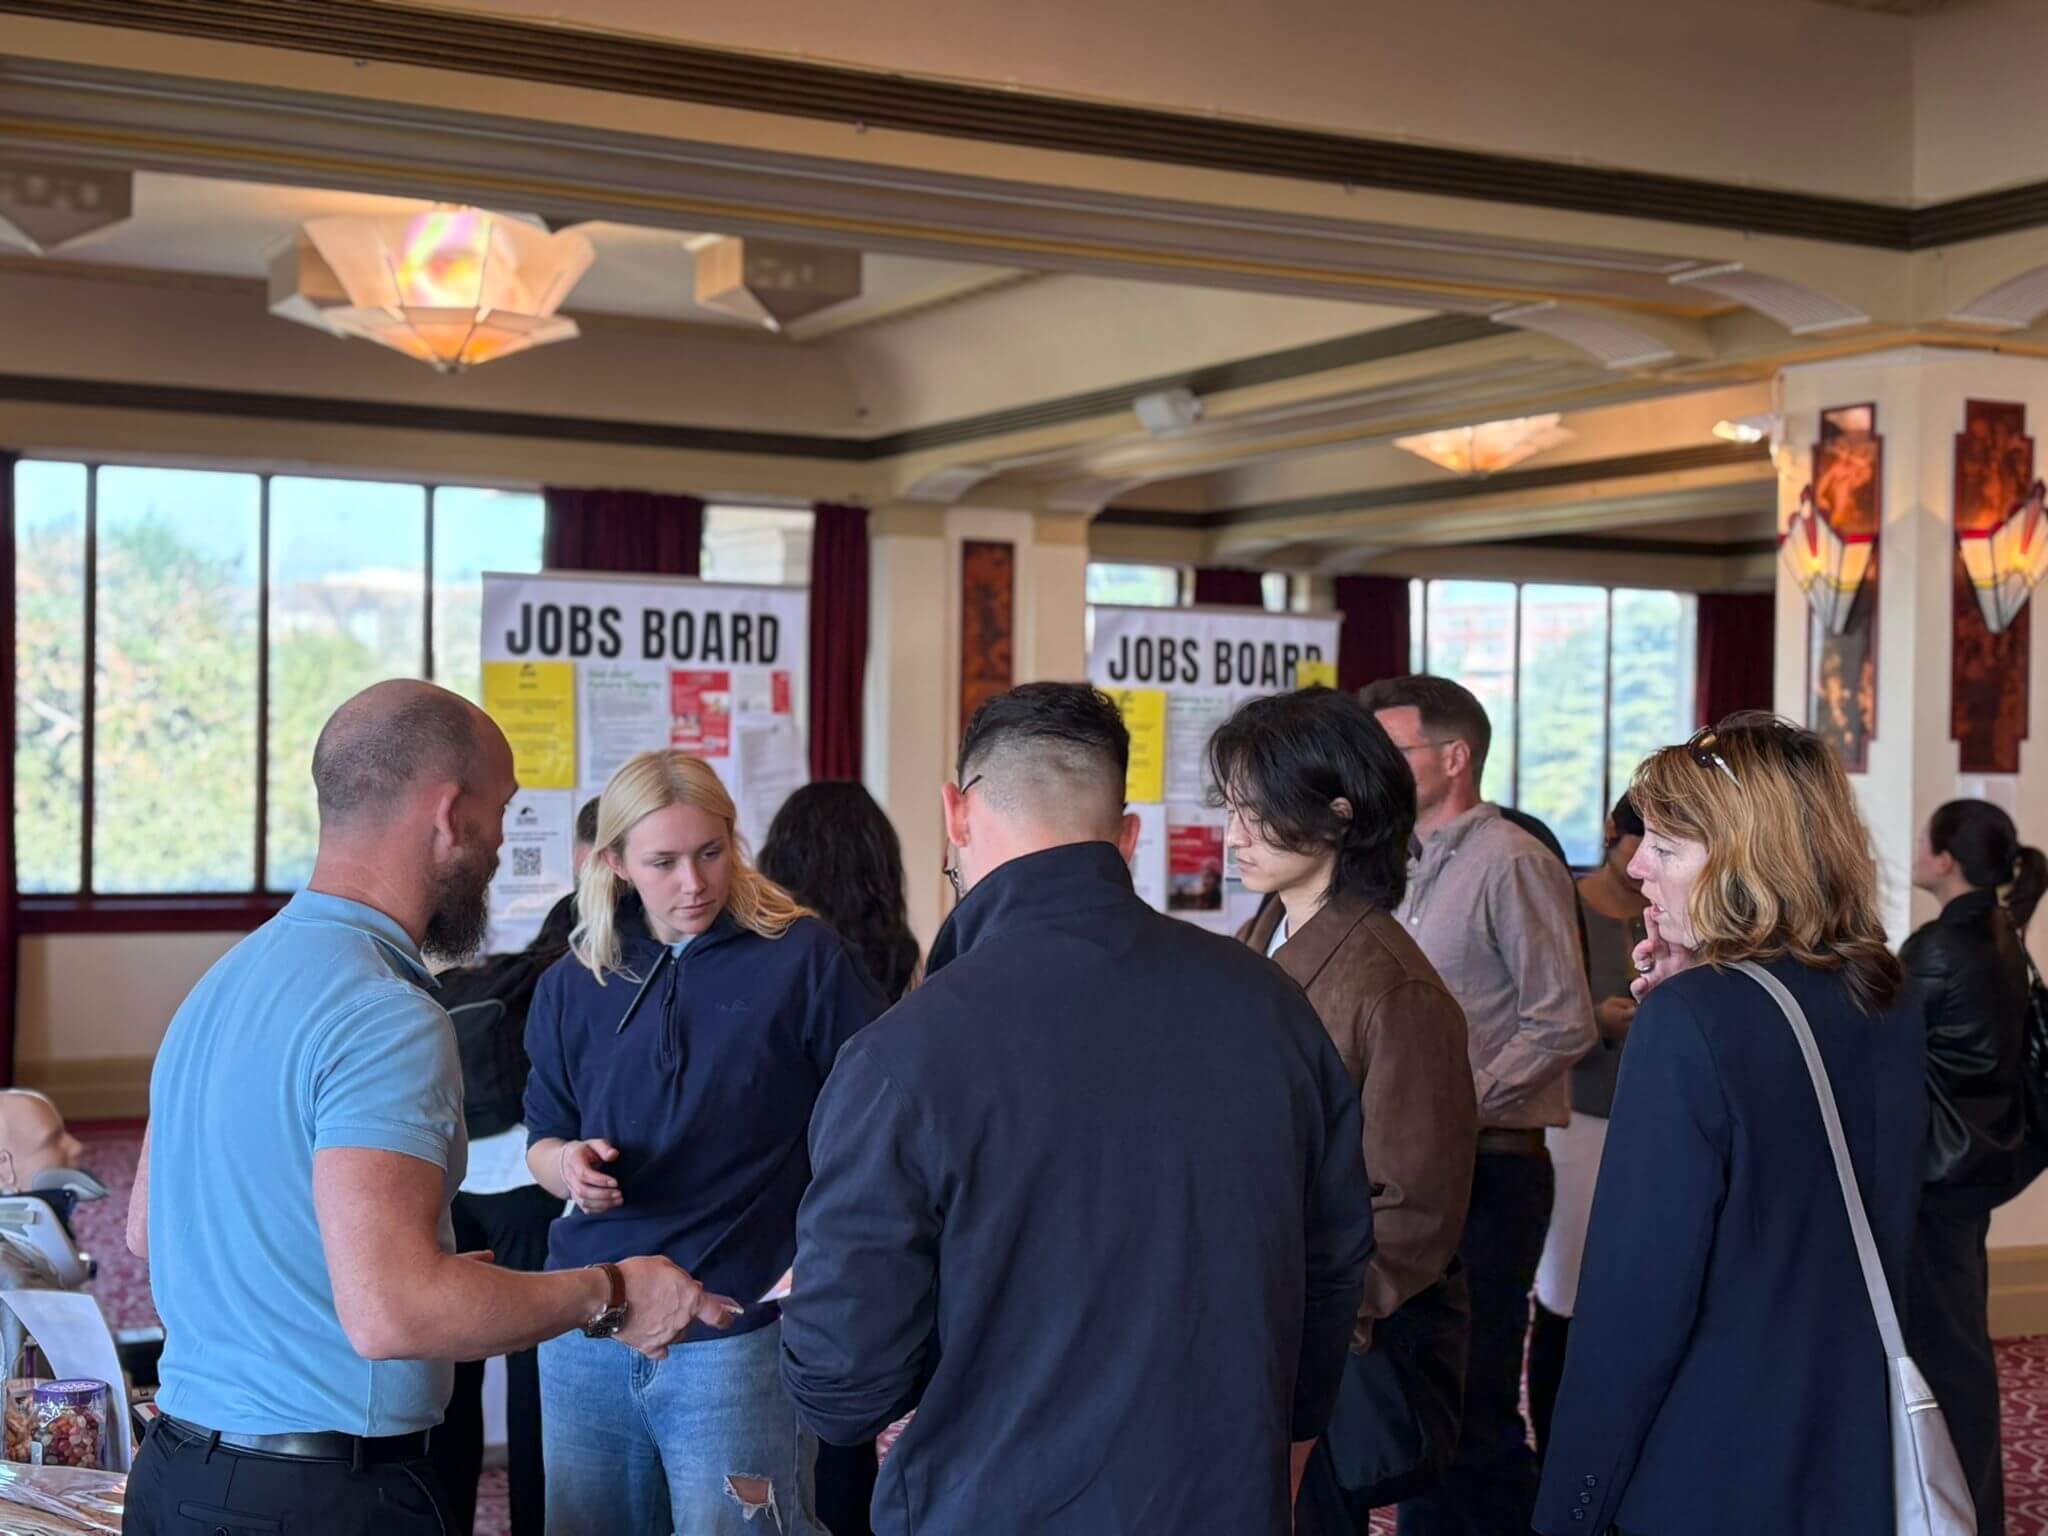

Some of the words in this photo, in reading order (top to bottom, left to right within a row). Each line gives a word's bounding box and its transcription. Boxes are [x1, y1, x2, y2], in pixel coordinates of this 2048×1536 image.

[506, 603, 622, 659] JOBS
[642, 609, 779, 665] BOARD
[1109, 636, 1199, 684] JOBS
